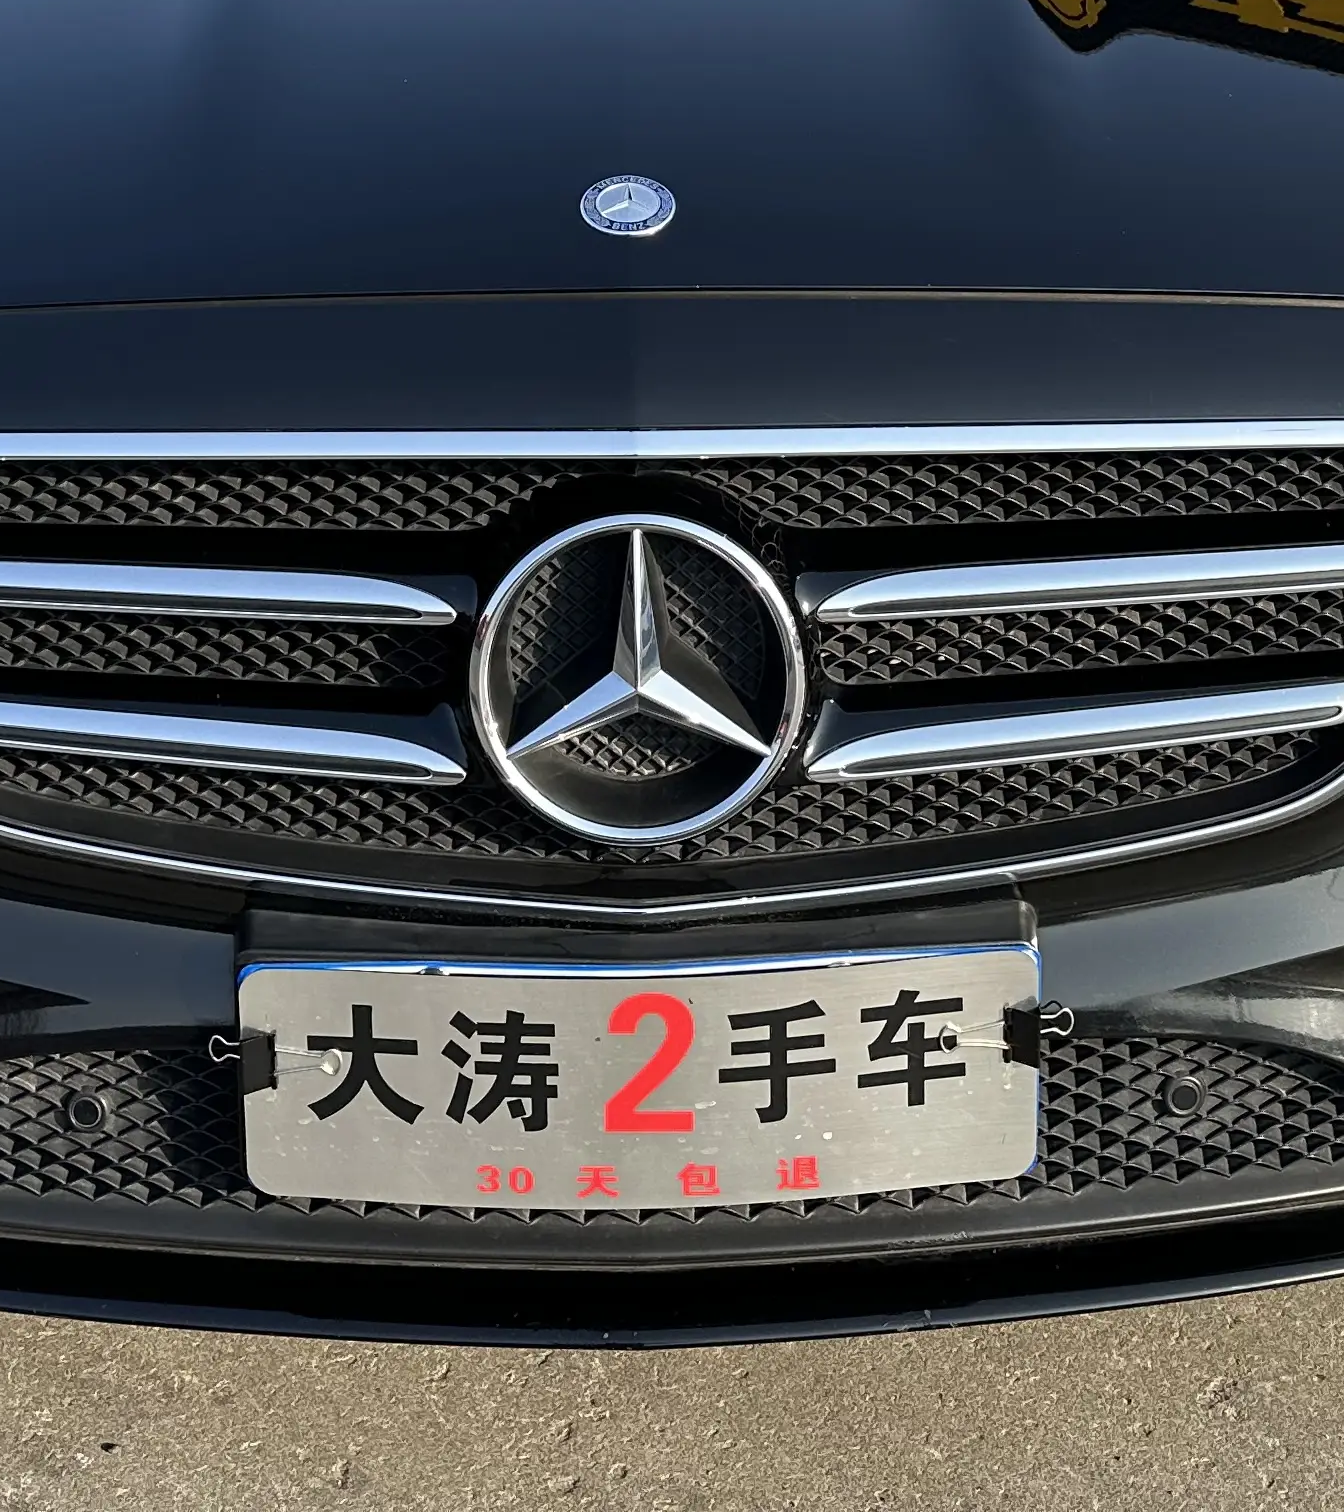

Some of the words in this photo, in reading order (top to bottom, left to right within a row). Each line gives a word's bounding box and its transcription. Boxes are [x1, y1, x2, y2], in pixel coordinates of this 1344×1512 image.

[307, 990, 967, 1134] 大涛2手车
[477, 1155, 820, 1199] 30天包退
